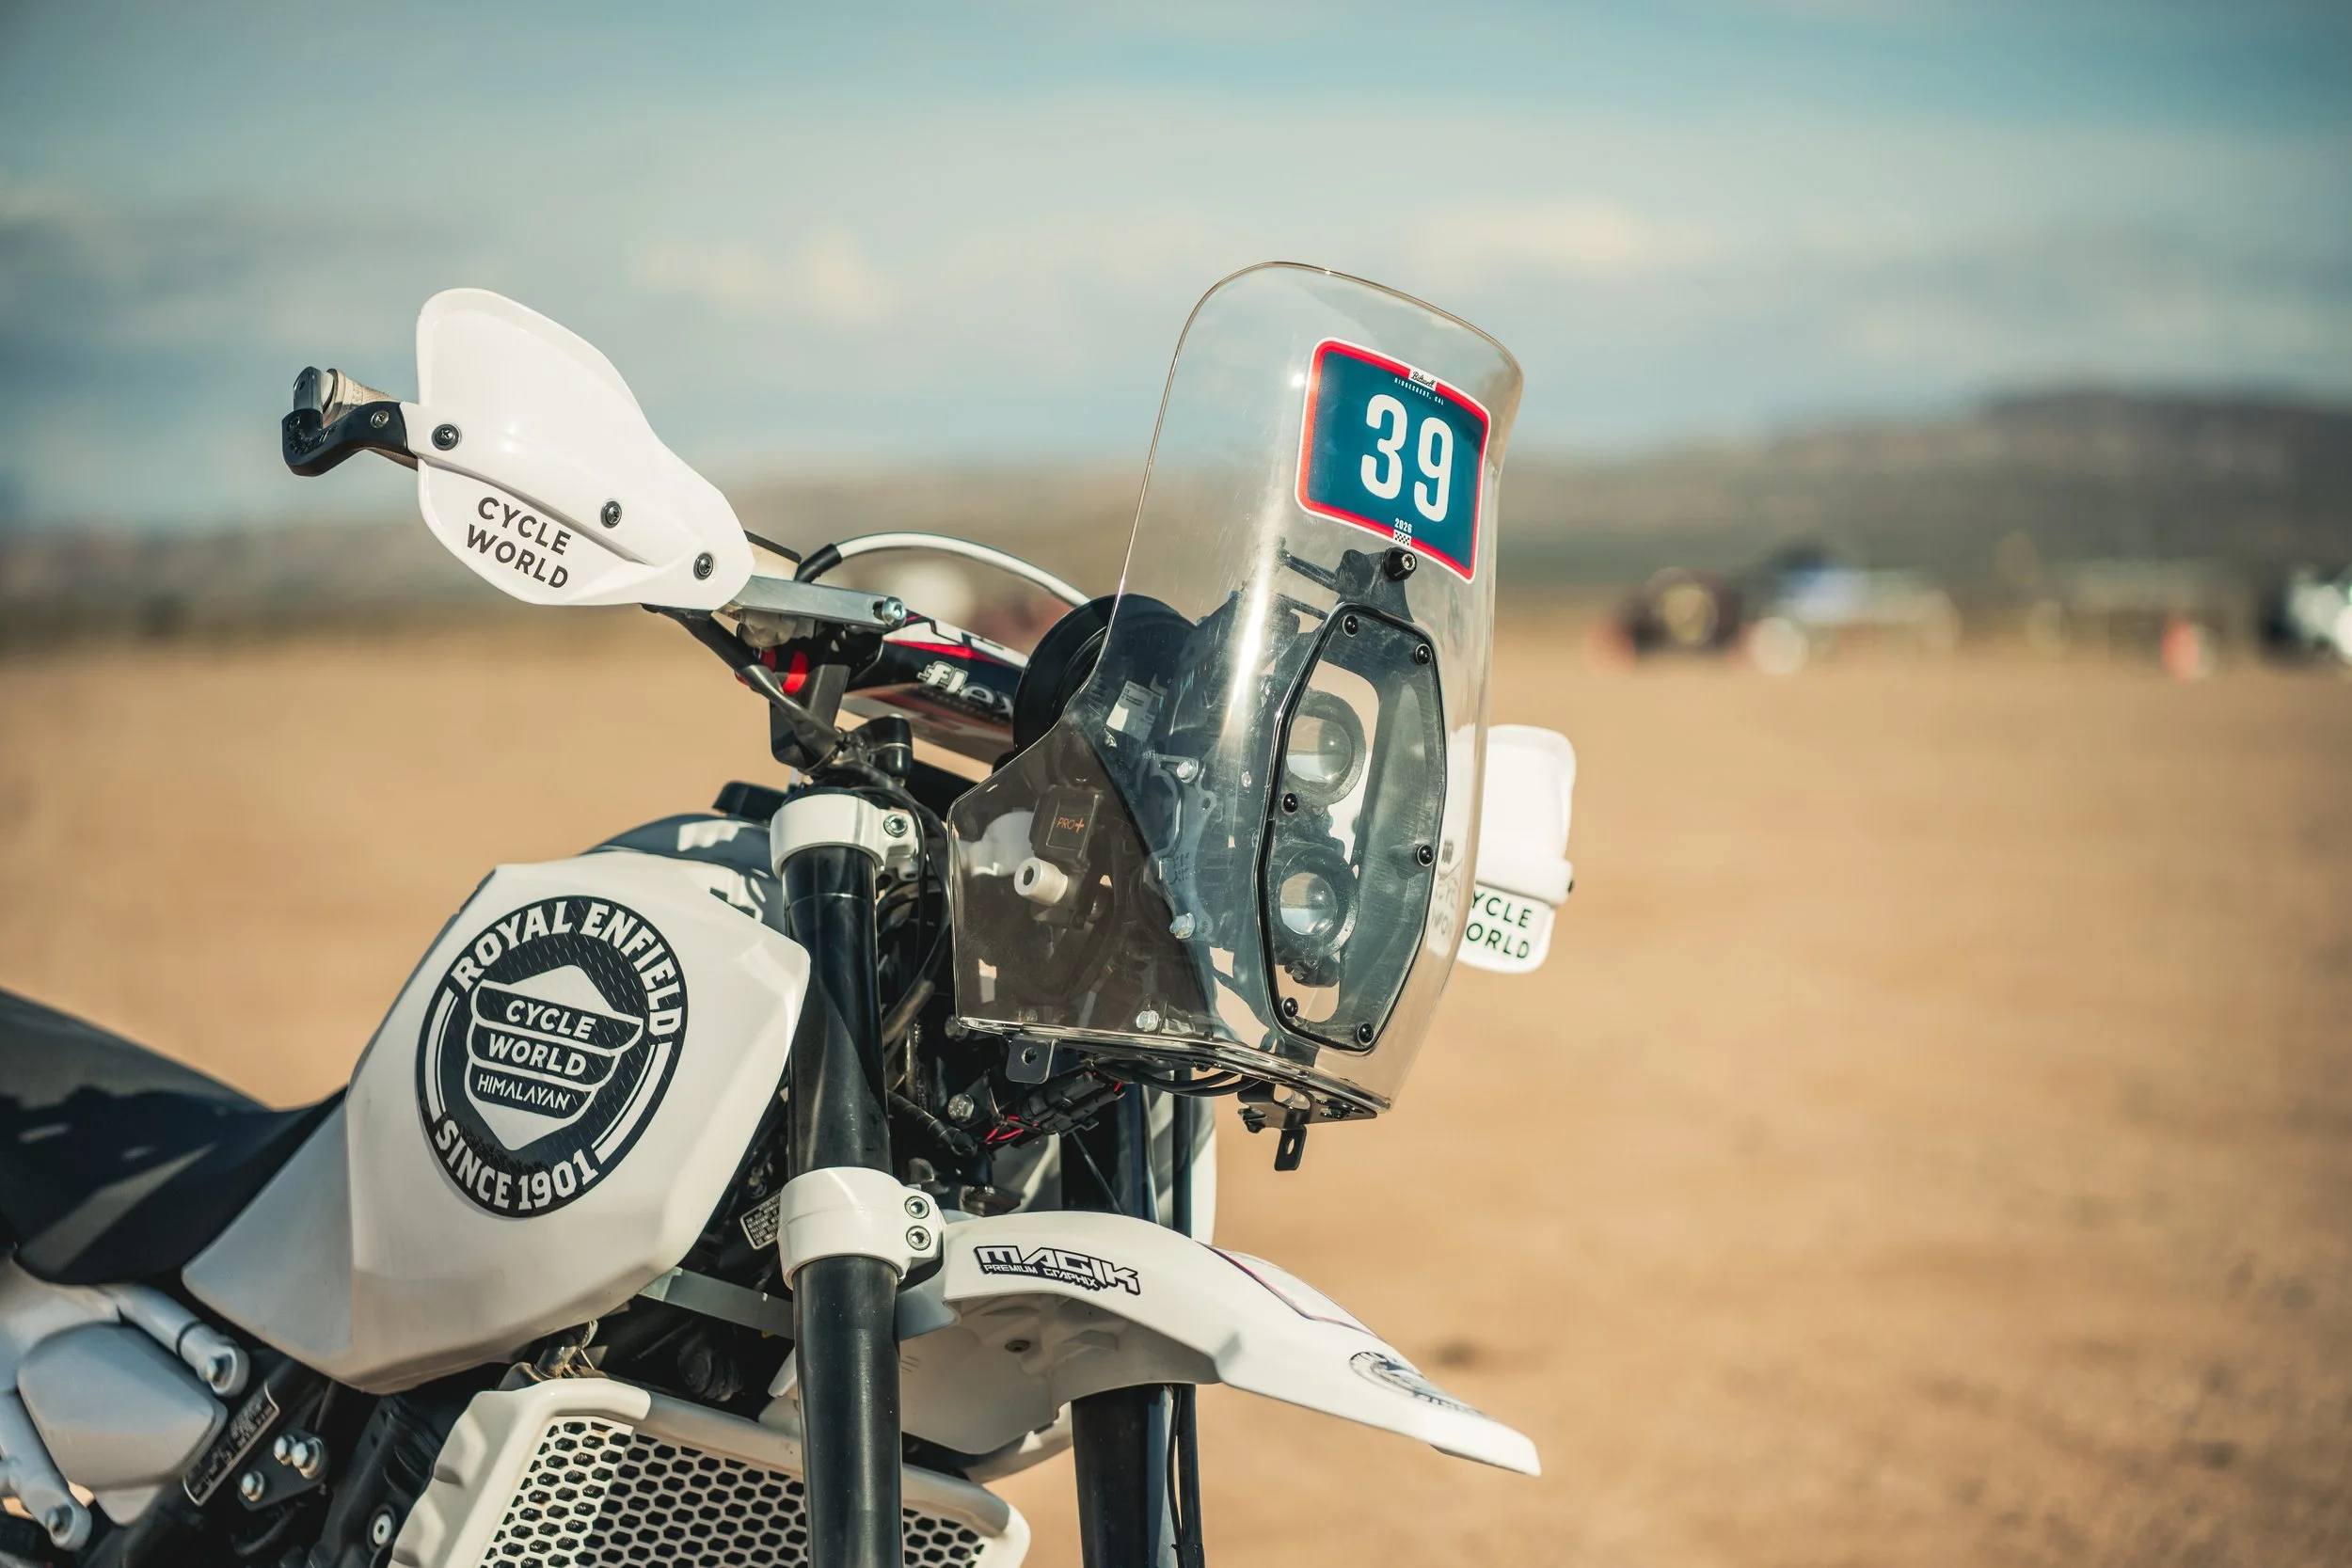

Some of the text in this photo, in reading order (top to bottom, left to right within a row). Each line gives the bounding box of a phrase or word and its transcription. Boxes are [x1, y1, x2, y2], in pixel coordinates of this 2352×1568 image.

[1360, 394, 1454, 522] 39
[478, 497, 571, 556] CYCLE
[1394, 517, 1412, 533] 2026
[467, 523, 568, 588] WORLD
[1471, 891, 1532, 928] YCLE
[1466, 923, 1530, 958] ORLD
[451, 900, 683, 1037] ROYAL ENFIELD
[505, 1000, 596, 1040] CYCLE
[487, 1033, 587, 1076] WORLD
[477, 1073, 570, 1111] HIMALAYAN
[435, 1119, 598, 1211] SINCE 1901
[974, 1245, 1140, 1295] MAGIK
[983, 1263, 1099, 1288] PREMIUM GRAPHIX
